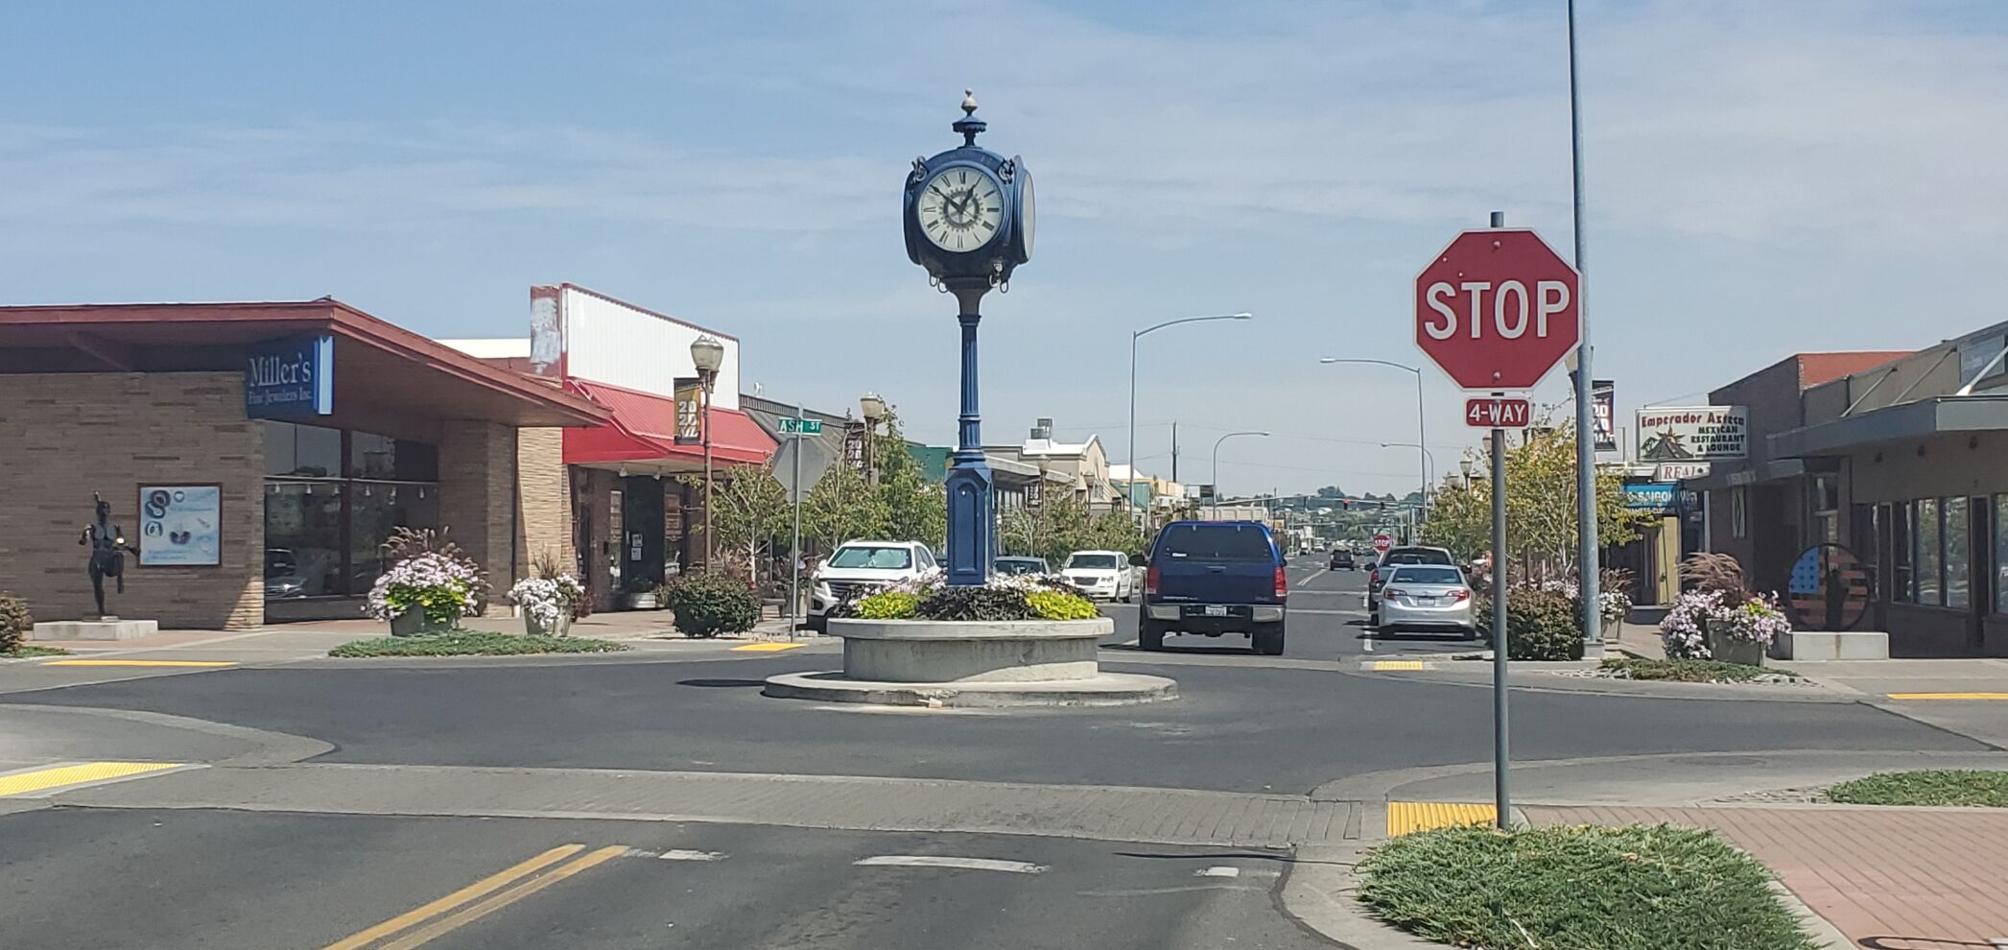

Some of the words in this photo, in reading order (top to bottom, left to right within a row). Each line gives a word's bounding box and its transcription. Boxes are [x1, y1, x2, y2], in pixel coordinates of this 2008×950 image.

[1424, 280, 1570, 340] STOP
[248, 352, 311, 387] Miller's
[1469, 404, 1526, 423] 4-WAY
[1642, 412, 1702, 428] Emperador
[1707, 412, 1745, 426] Azteca
[780, 420, 804, 433] ASH
[810, 421, 821, 430] ST
[1698, 426, 1738, 434] MEXICAN
[1691, 434, 1744, 444] RESTAURANT
[1706, 443, 1740, 452] LOUNGE
